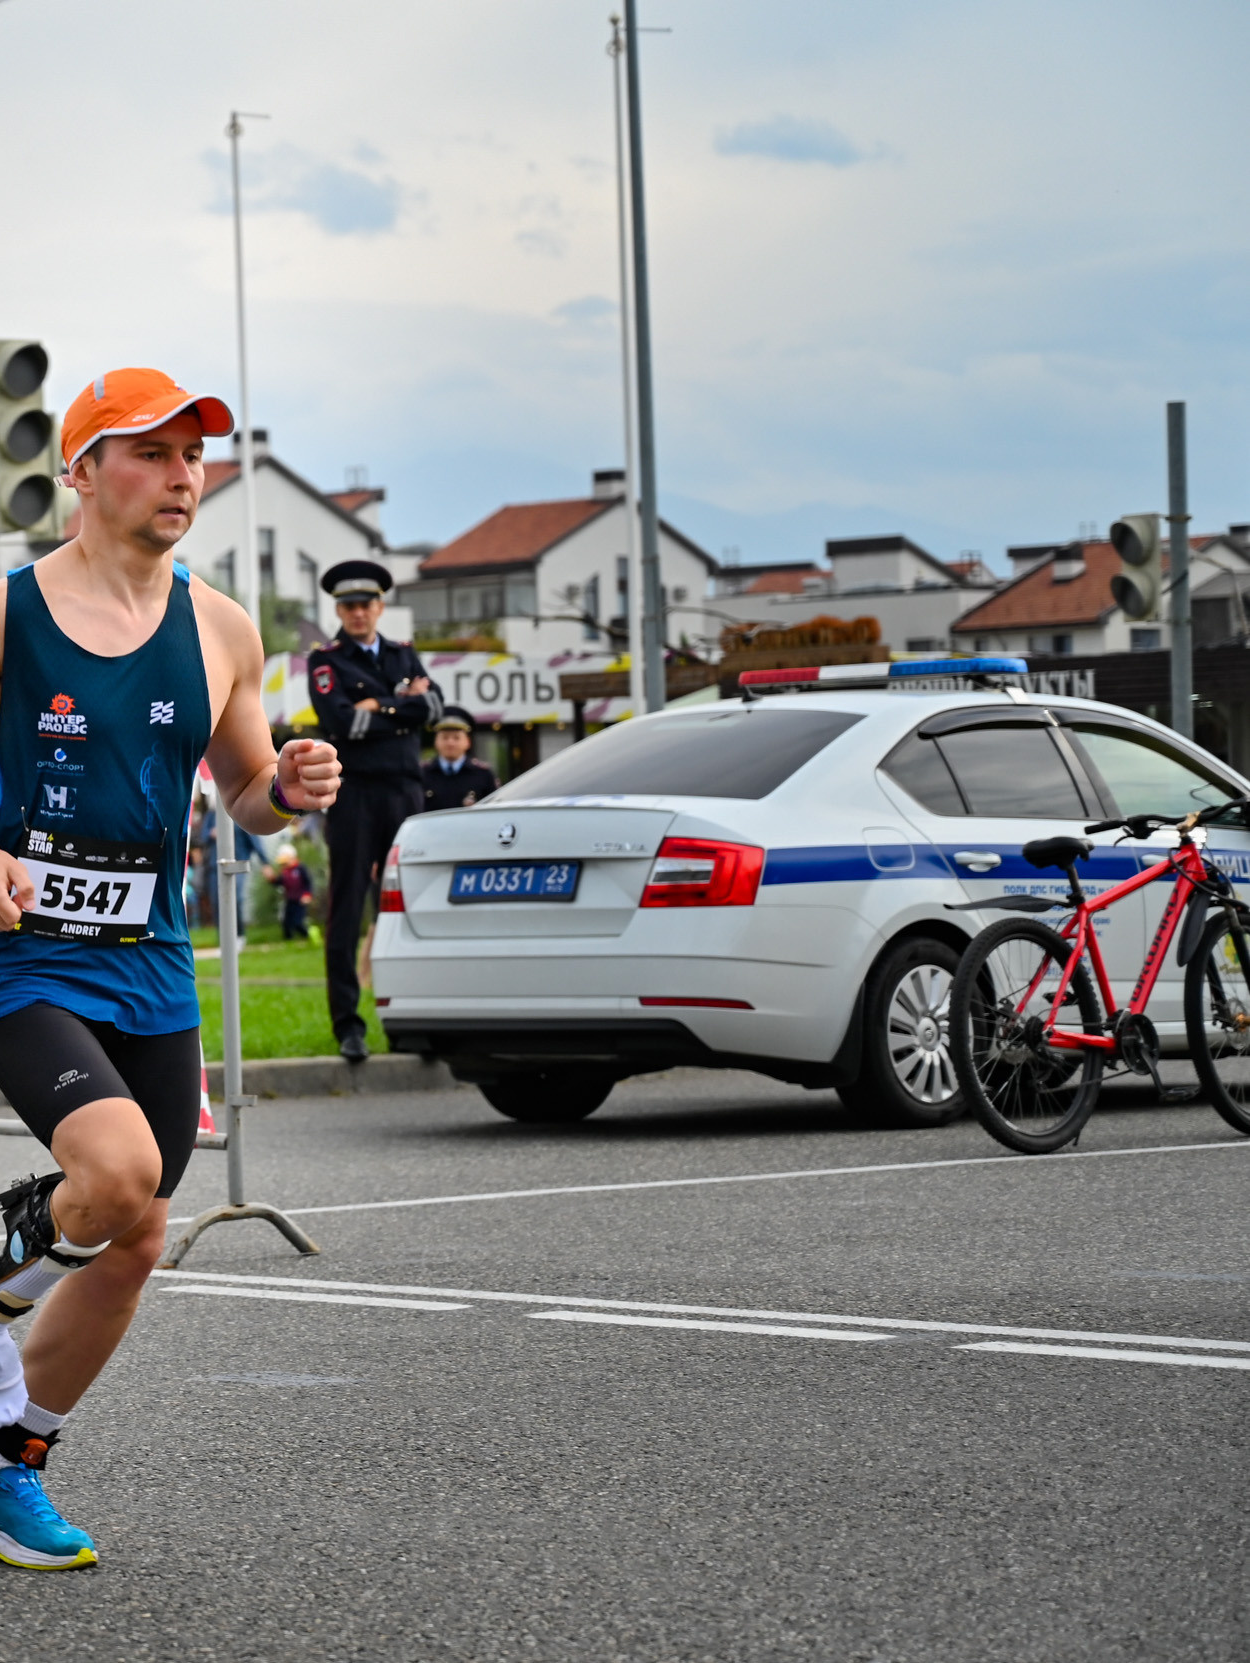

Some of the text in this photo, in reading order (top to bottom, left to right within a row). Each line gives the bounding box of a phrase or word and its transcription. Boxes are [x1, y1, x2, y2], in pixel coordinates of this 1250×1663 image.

[40, 712, 86, 725] ИНТЕР
[30, 829, 48, 842] IRON
[27, 838, 53, 855] STAR
[480, 865, 535, 895] 0331
[546, 863, 570, 885] 23
[39, 872, 131, 916] 5547
[60, 922, 101, 937] ANDREY
